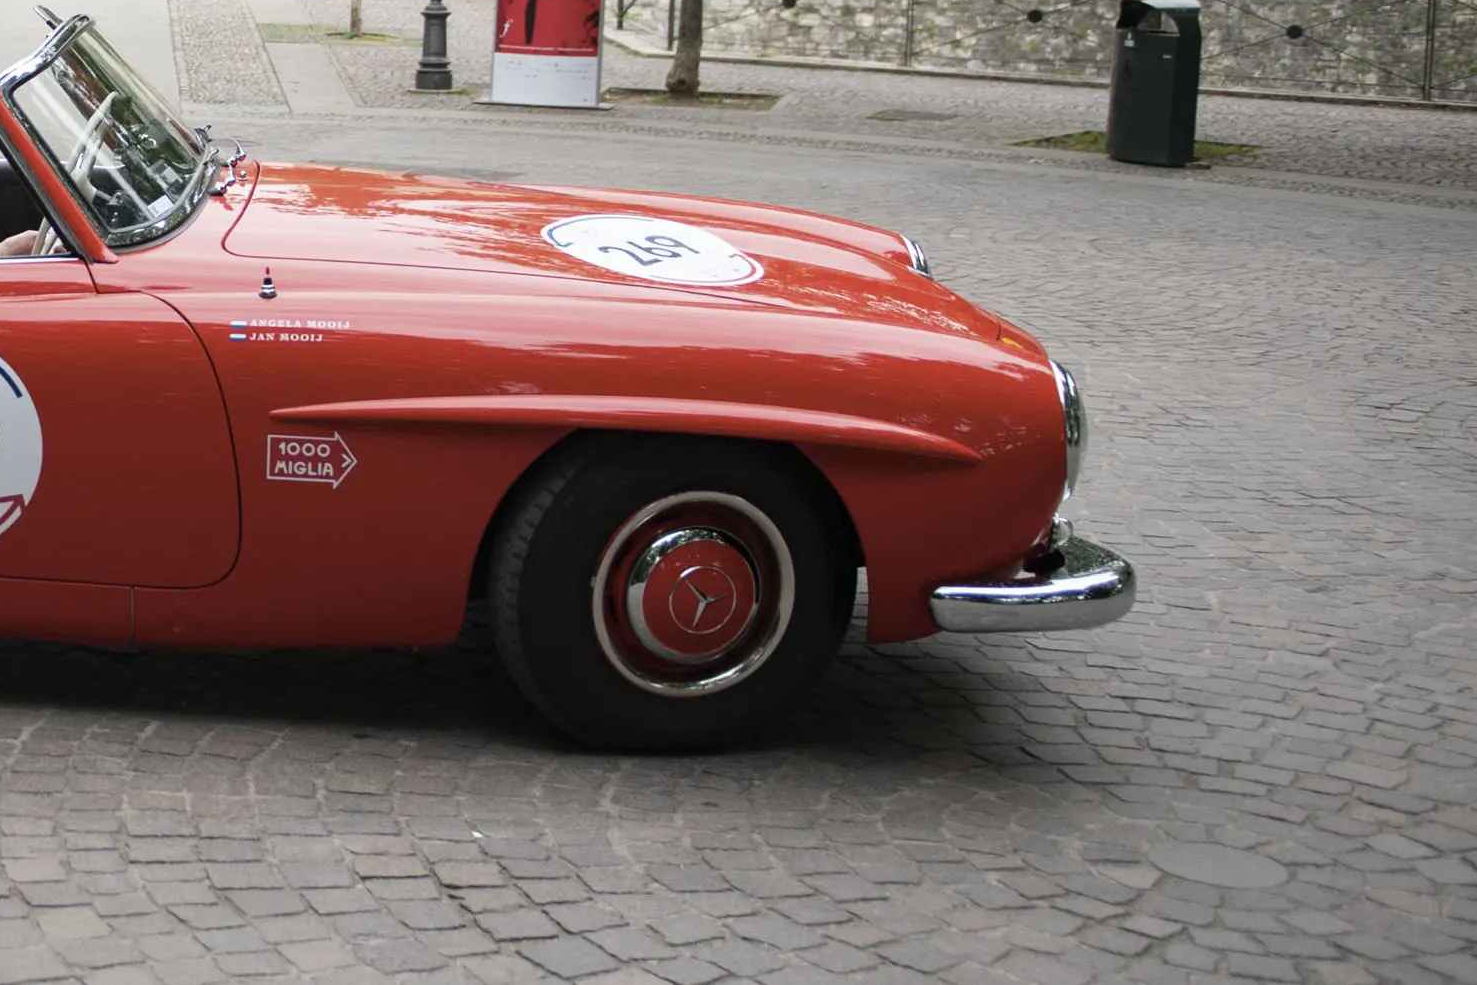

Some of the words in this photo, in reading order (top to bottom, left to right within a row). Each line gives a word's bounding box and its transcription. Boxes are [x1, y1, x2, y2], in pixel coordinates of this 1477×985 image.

[598, 235, 699, 267] 269
[249, 319, 302, 328] ANGELA
[307, 320, 351, 329] MOOIJ
[249, 332, 275, 341] JAN
[280, 333, 323, 342] MOOIJ
[278, 442, 331, 458] 1000
[274, 460, 334, 477] MIGLIA
